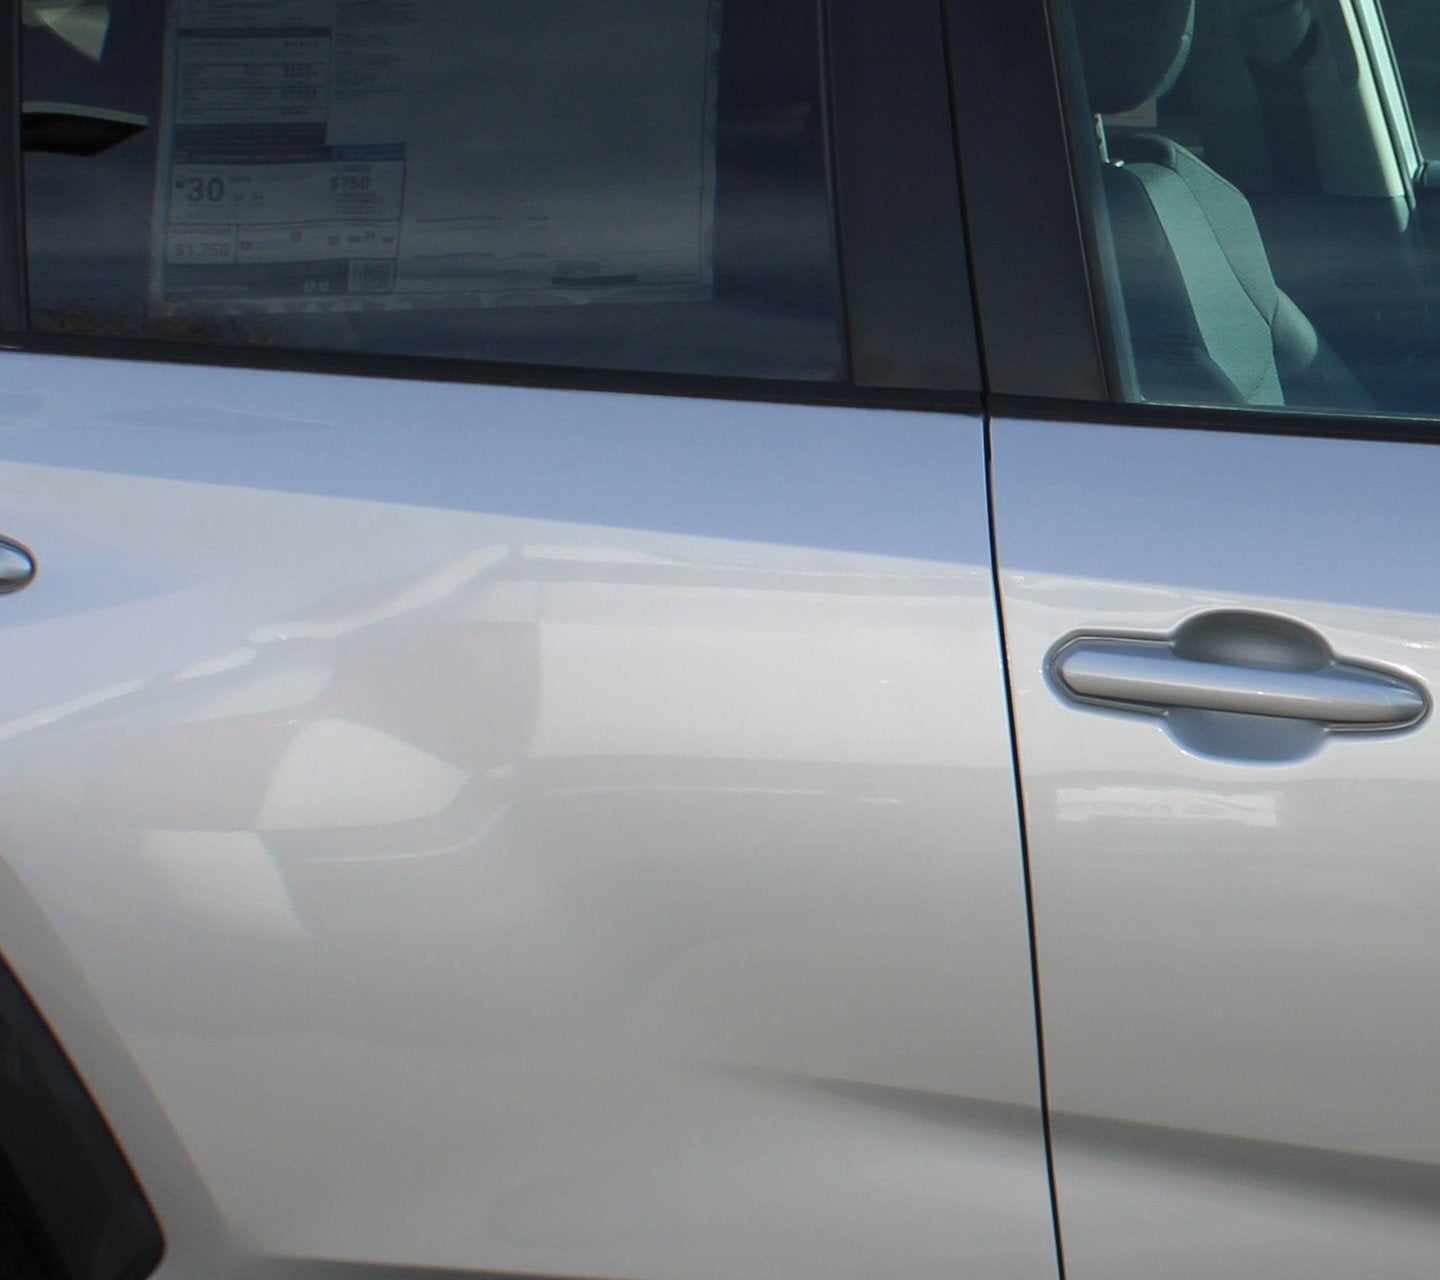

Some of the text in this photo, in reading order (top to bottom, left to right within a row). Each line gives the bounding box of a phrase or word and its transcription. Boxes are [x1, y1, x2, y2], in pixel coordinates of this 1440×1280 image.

[186, 176, 225, 203] 30
[329, 175, 371, 190] $750
[174, 241, 230, 260] $1,750
